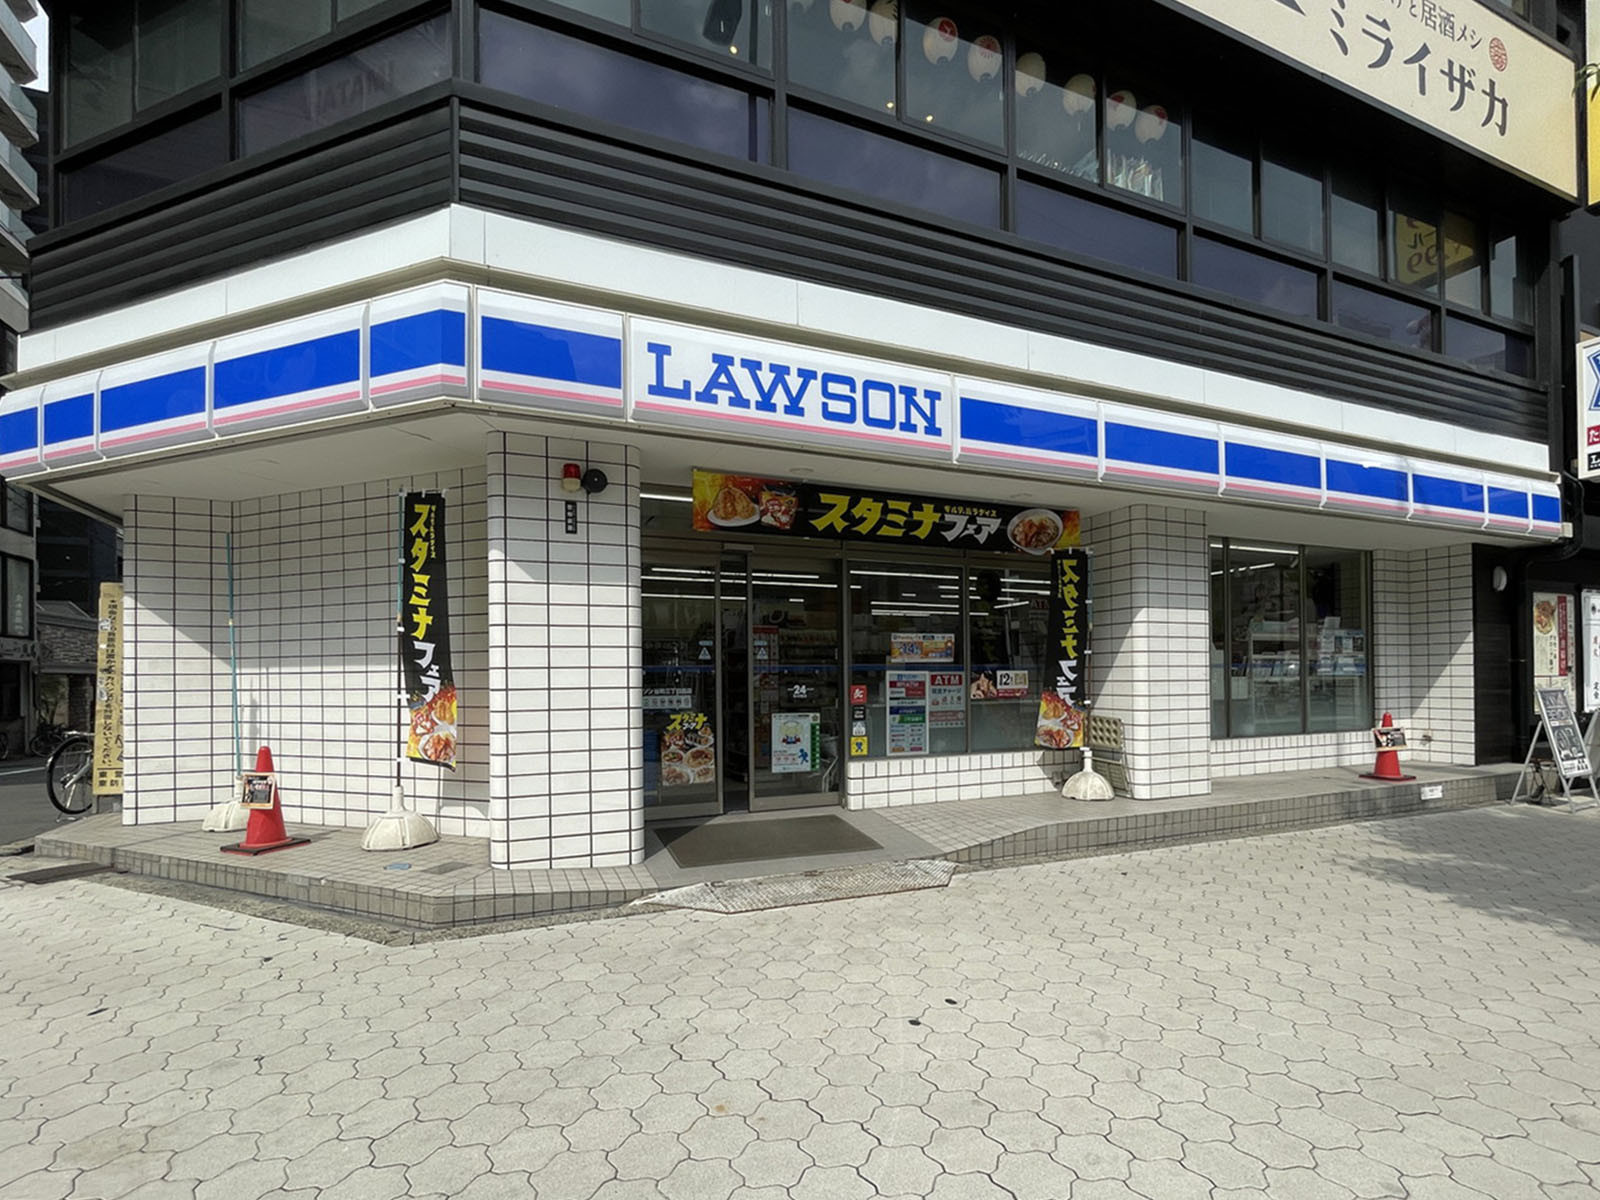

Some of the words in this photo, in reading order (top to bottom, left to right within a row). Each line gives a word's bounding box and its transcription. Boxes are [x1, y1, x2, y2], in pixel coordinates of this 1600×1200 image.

[647, 342, 942, 437] LAWSON
[409, 503, 441, 703] スタミナフェア
[934, 675, 960, 686] ATM
